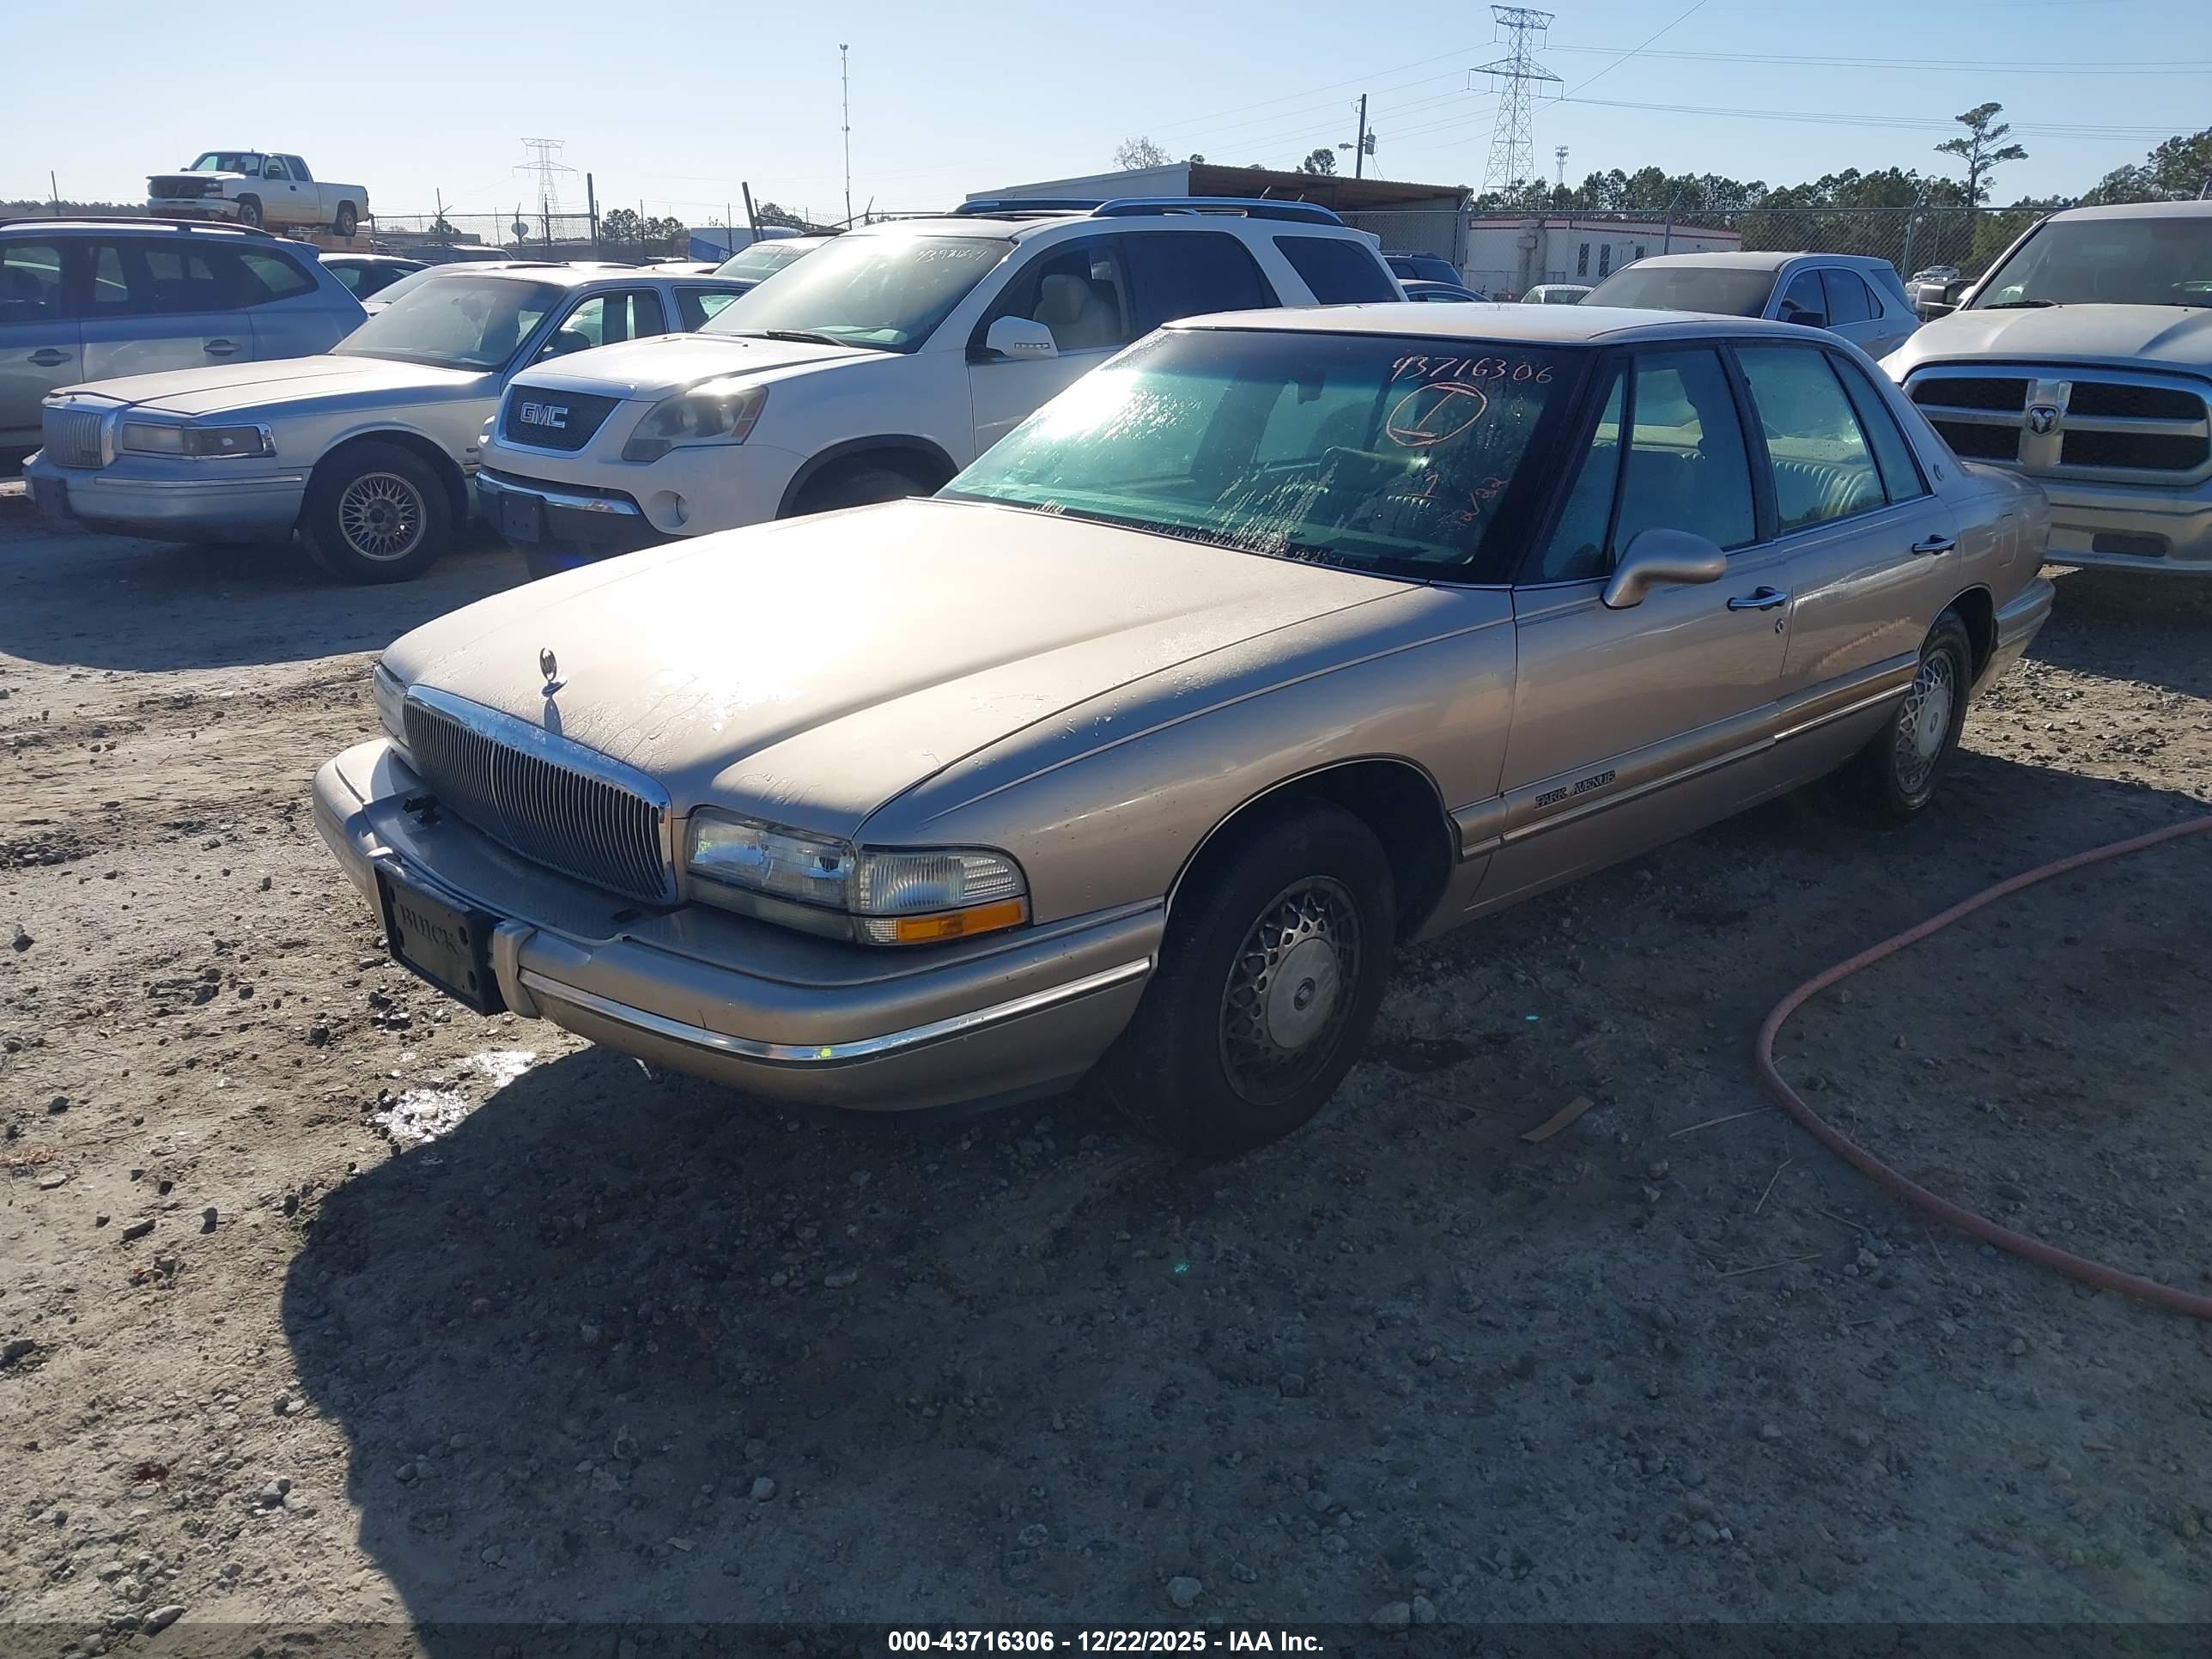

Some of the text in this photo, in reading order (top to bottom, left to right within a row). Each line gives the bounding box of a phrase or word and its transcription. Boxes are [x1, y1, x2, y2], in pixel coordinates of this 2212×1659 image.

[520, 402, 568, 428] GMC
[1535, 770, 1615, 809] PARK AVENUE
